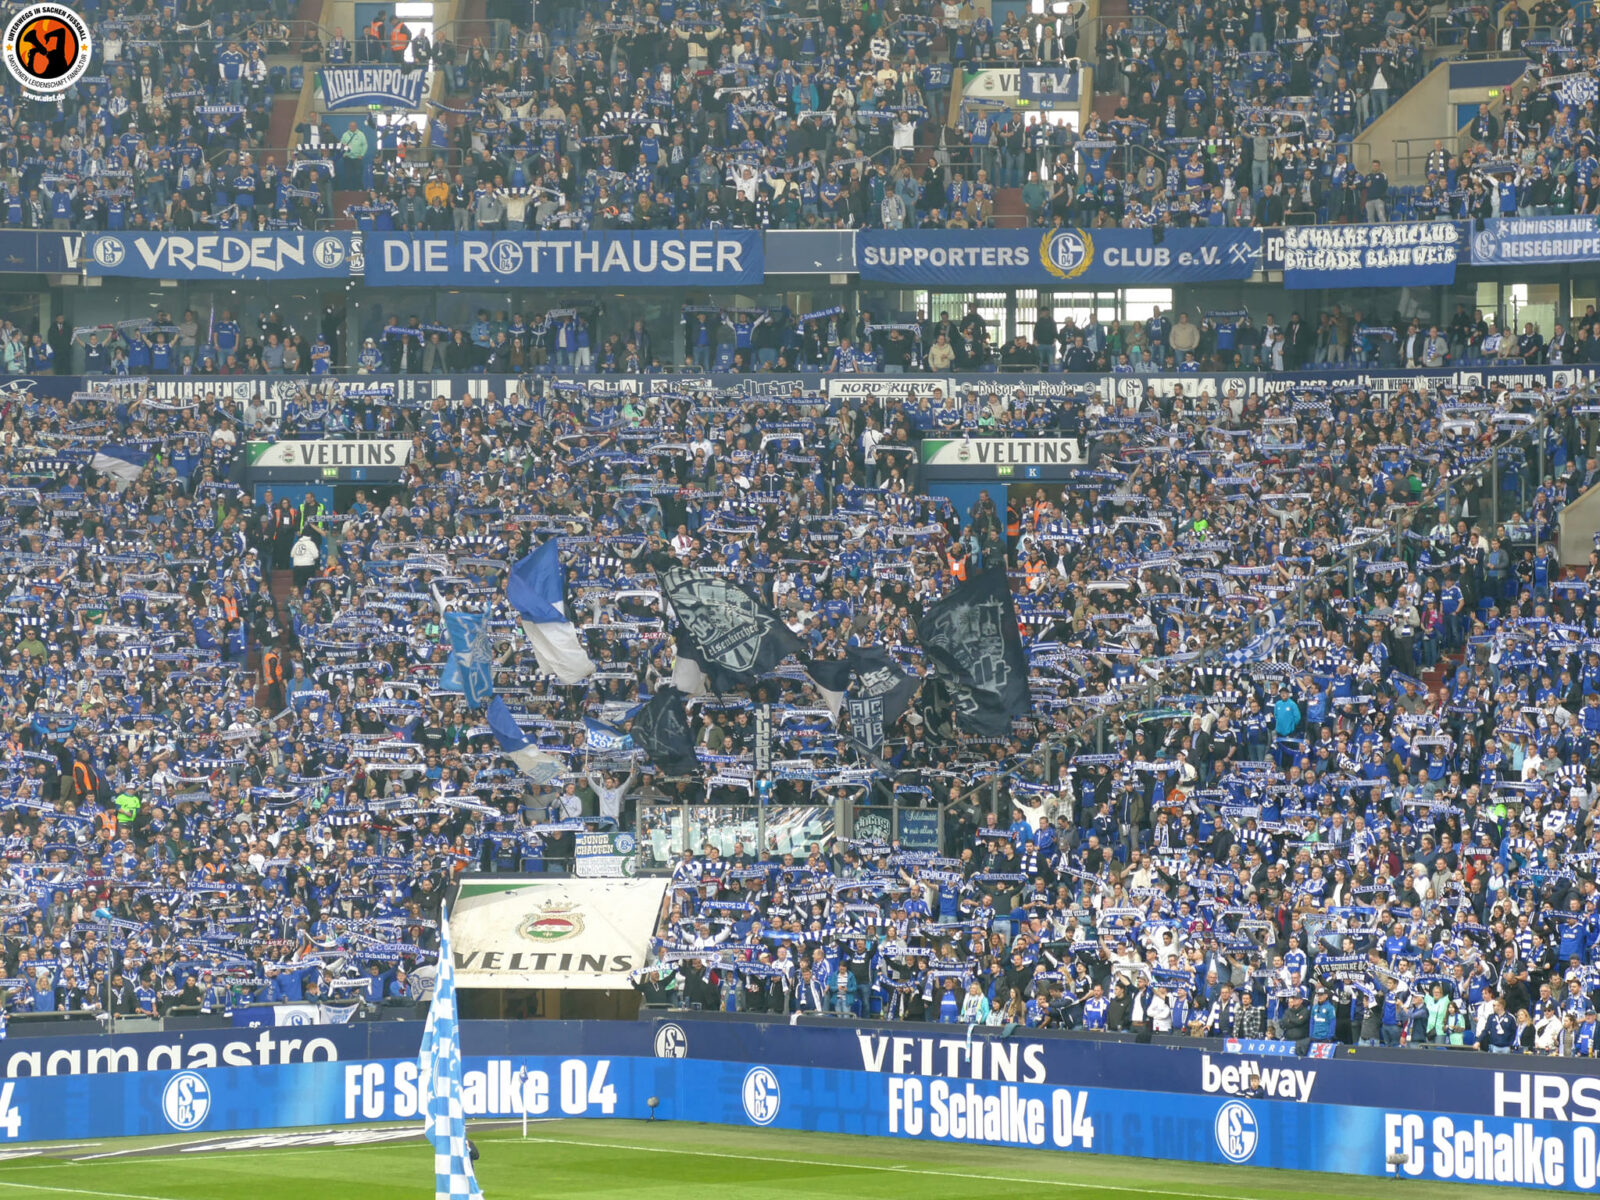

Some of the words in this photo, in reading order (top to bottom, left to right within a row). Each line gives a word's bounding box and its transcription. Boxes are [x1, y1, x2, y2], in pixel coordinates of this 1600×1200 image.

[324, 68, 422, 101] KOHLENPOTT
[930, 71, 941, 83] 22
[1285, 226, 1369, 248] SCHALKE
[1370, 223, 1459, 247] FANCLUB
[1510, 218, 1593, 236] KÖNIGSBLAUE
[134, 236, 305, 272] VREDEN
[384, 240, 449, 272] DIE
[864, 246, 1030, 268] SUPPORTERS
[1103, 247, 1171, 267] CLUB
[1178, 246, 1221, 266] e.V.
[1365, 249, 1412, 268] BLAU
[1501, 238, 1600, 258] REISEGRUPPE
[841, 382, 881, 394] NORD
[891, 382, 937, 394] KURVE
[1370, 379, 1386, 390] WIR
[301, 444, 396, 464] VELTINS
[976, 443, 1072, 463] VELTINS
[1028, 468, 1037, 477] K
[581, 834, 609, 845] JUNGE
[452, 951, 633, 972] VELTINS
[857, 1034, 1047, 1085] VELTINS
[344, 1064, 384, 1119] FC
[394, 1060, 549, 1118] Salke
[560, 1059, 617, 1115] 04
[1202, 1055, 1316, 1103] betway
[1493, 1071, 1600, 1123] HRS
[888, 1077, 923, 1135] FC
[930, 1079, 1045, 1145] Schalke
[1052, 1088, 1094, 1148] 04
[1385, 1113, 1425, 1176] FC
[1432, 1116, 1564, 1187] Schalke
[1573, 1126, 1600, 1189] 0
